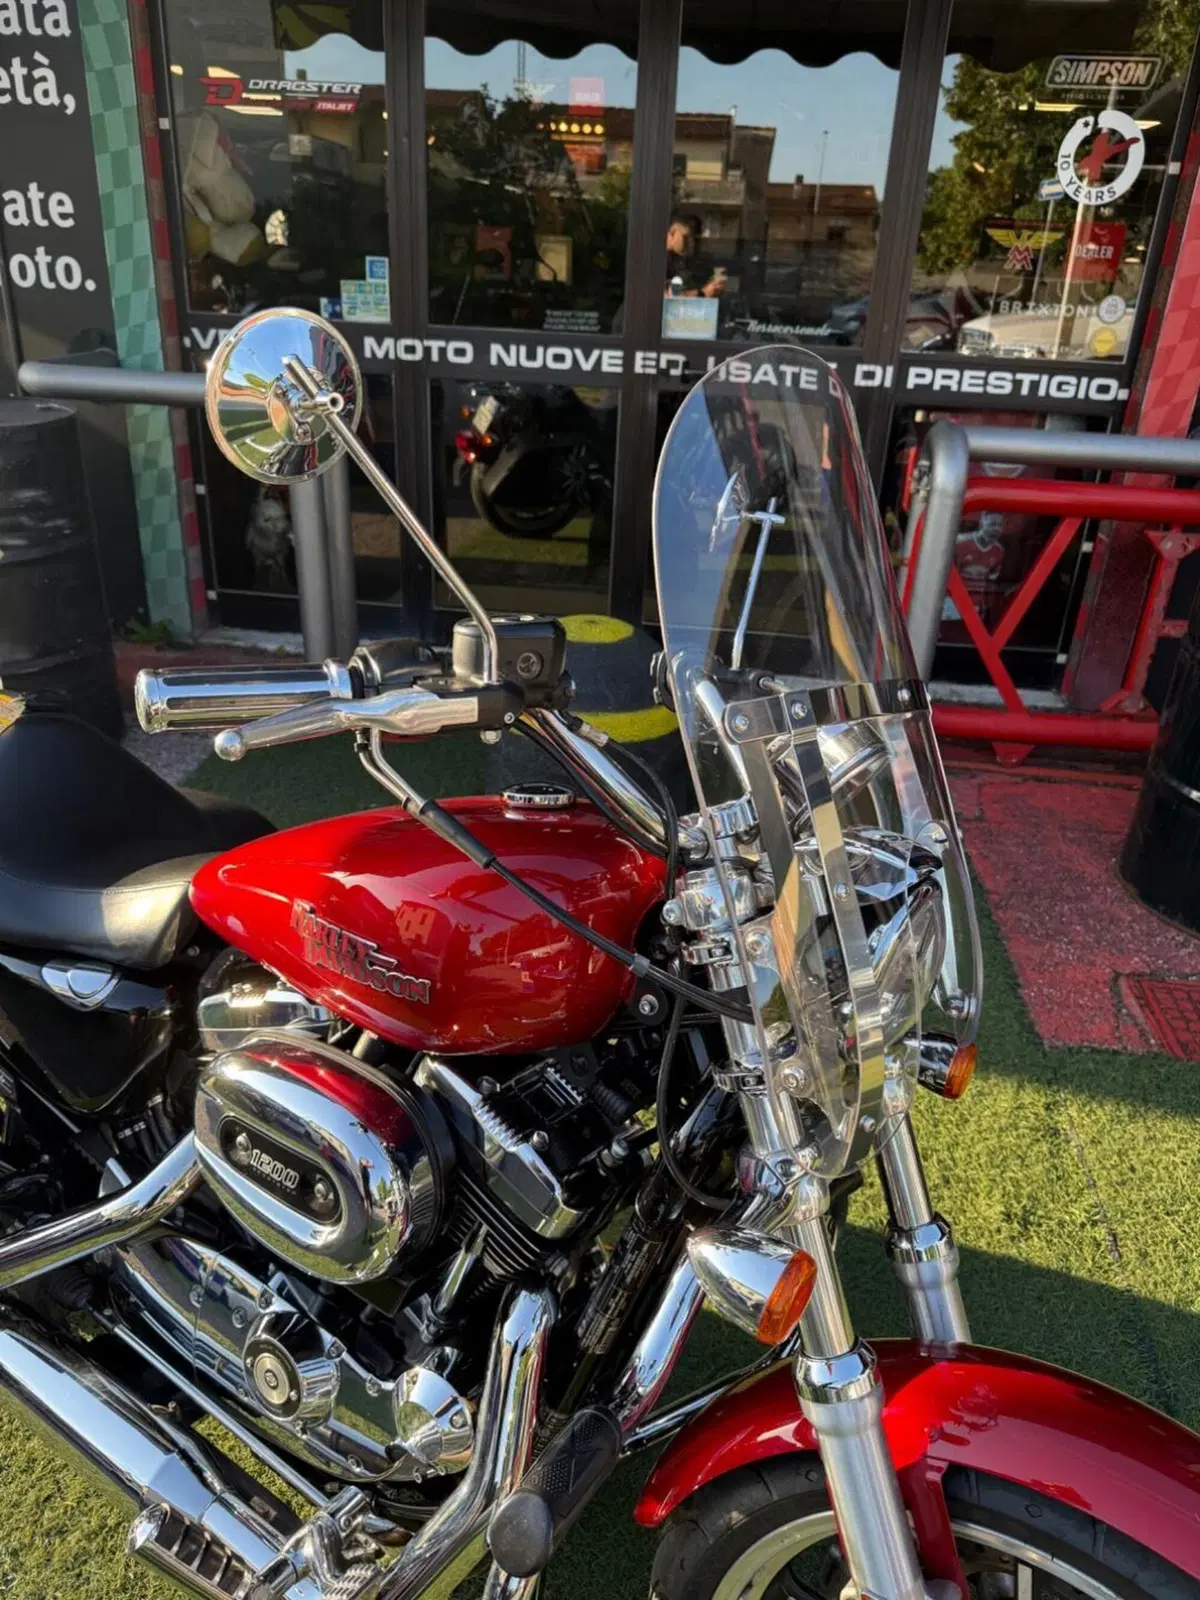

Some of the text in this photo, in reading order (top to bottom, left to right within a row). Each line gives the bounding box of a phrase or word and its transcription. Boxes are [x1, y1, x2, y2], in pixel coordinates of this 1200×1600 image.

[249, 79, 363, 94] DRAGSTER
[1054, 61, 1151, 85] SIMPSON
[2, 181, 76, 228] ate
[1066, 175, 1117, 202] YEARS
[9, 245, 97, 292] oto.
[1000, 301, 1091, 319] BRIXTON
[363, 336, 474, 364] MOTO
[490, 343, 624, 374] NUOVE
[854, 363, 894, 388] DI
[906, 366, 1130, 400] PRESTIGIO.
[250, 1149, 300, 1189] 1200
